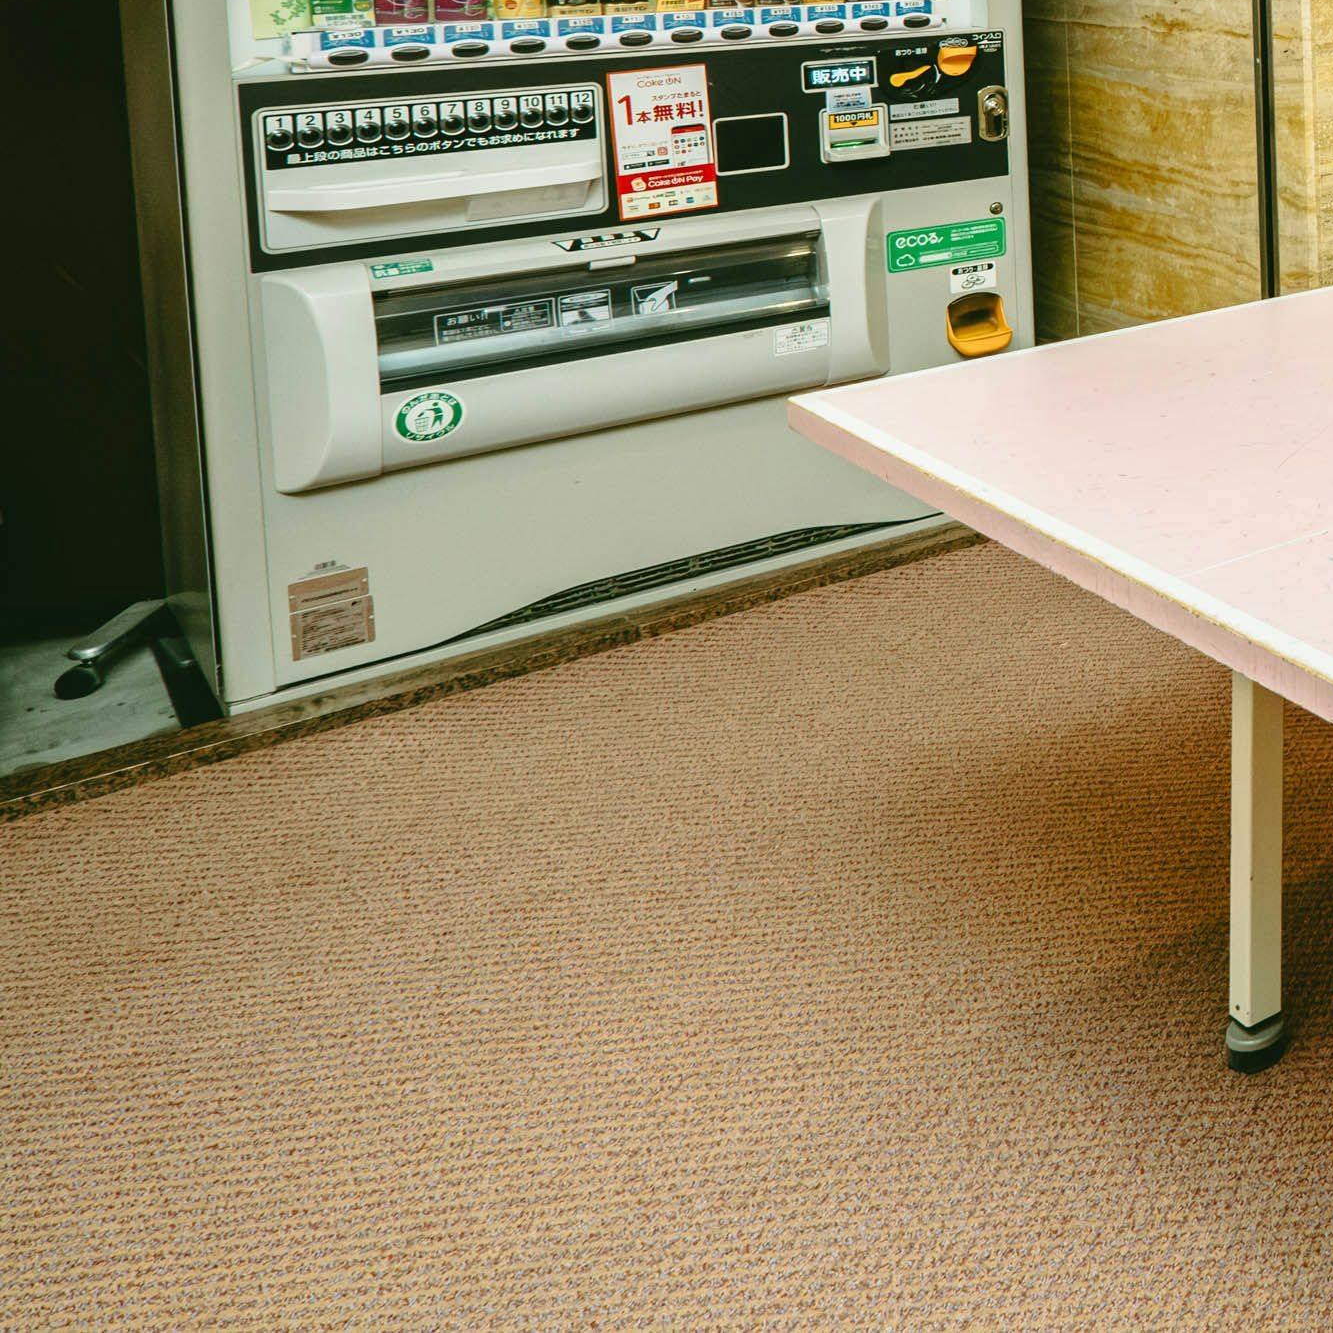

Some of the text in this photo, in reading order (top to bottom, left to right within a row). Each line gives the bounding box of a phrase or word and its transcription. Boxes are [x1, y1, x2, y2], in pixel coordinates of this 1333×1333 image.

[812, 68, 867, 85] 販売中
[636, 78, 664, 89] Coke
[524, 97, 540, 108] 10
[550, 95, 564, 106] 11
[574, 93, 590, 104] 12
[448, 104, 457, 114] 7
[475, 101, 484, 112] 8
[501, 99, 510, 110] 9
[364, 111, 374, 121] 4
[393, 108, 402, 119] 5
[420, 106, 430, 116] 6
[305, 115, 315, 126] 2
[335, 113, 344, 124] 3
[834, 112, 873, 122] 1000円札
[276, 118, 283, 129] 1
[287, 128, 581, 165] 最上段の商品はこちらのボタンでもお求めになれます
